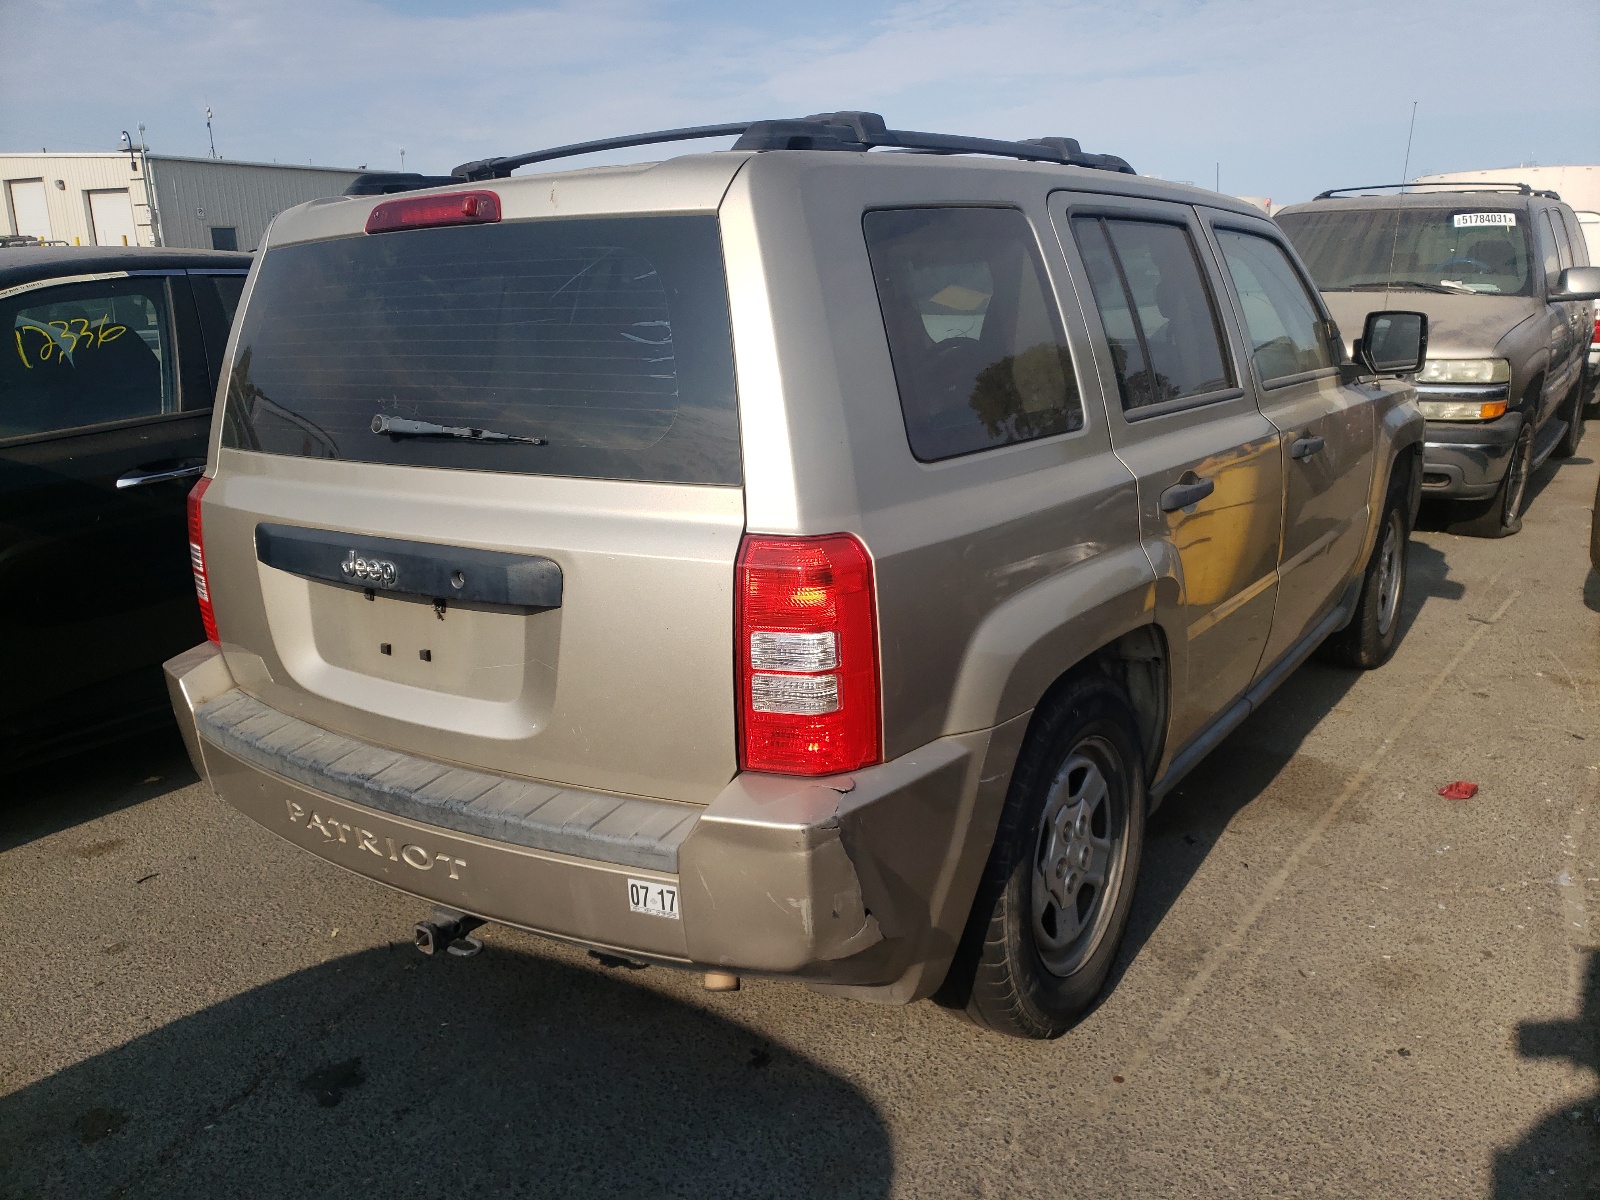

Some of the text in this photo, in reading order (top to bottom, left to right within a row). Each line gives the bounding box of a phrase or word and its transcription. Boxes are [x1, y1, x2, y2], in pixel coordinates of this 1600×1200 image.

[1462, 214, 1507, 225] 51784031
[341, 550, 397, 588] Jeep
[285, 799, 467, 880] PATRIOT
[630, 883, 649, 907] 07
[657, 889, 676, 912] 17
